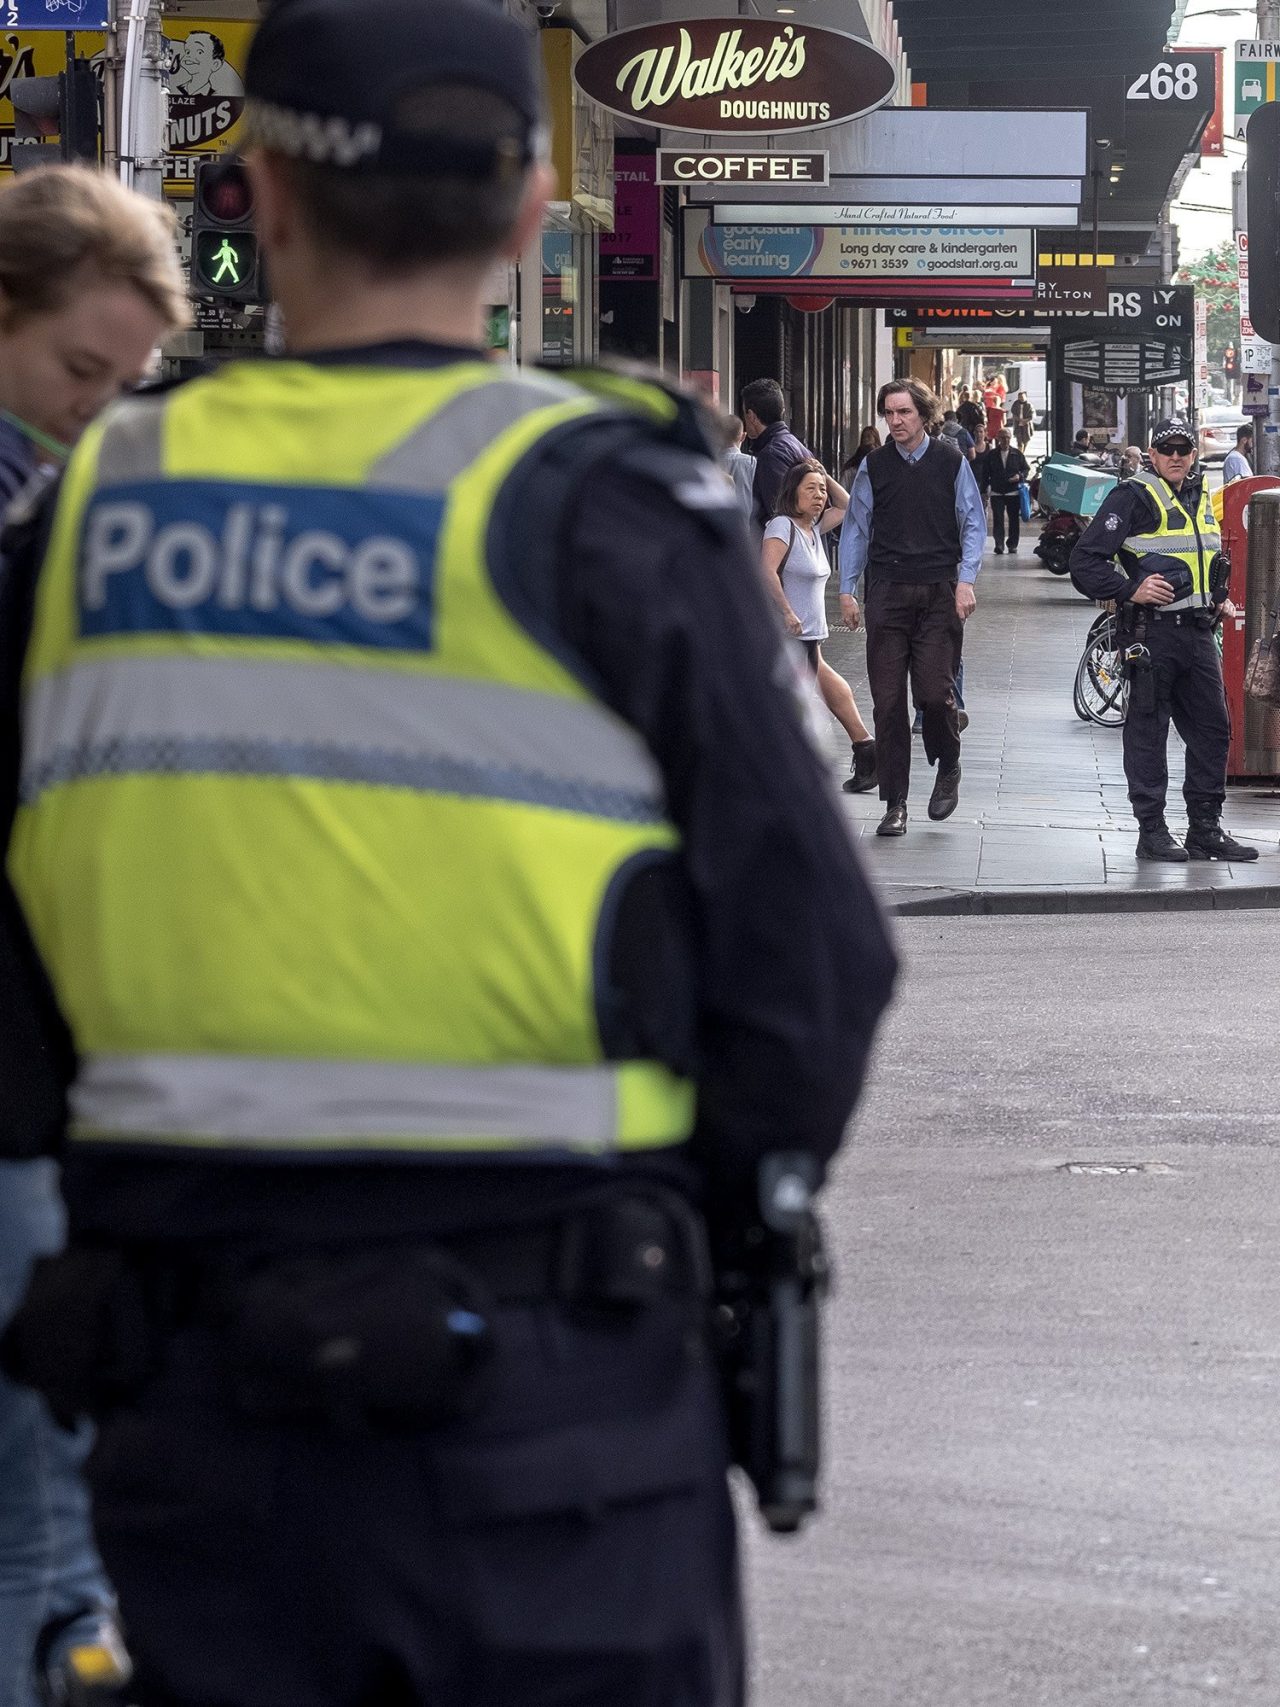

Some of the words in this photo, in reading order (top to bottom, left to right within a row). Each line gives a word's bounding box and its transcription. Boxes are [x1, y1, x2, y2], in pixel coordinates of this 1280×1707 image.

[6, 12, 19, 27] 2
[616, 26, 806, 111] Walker's
[720, 100, 831, 120] DOUGHNUTS
[673, 157, 813, 180] COFFEE
[864, 207, 896, 222] Crafted
[898, 207, 932, 220] Natural
[602, 232, 632, 244] 2017
[722, 236, 765, 253] early
[840, 243, 869, 256] Long
[872, 243, 895, 256] day
[899, 245, 926, 254] care
[929, 243, 938, 254] &
[941, 243, 1017, 256] kindergarten
[723, 251, 790, 270] learning
[851, 259, 878, 269] 9671
[881, 259, 909, 269] 3539
[927, 258, 1018, 271] goodstart.org.au
[1038, 282, 1057, 290] BY
[1037, 291, 1092, 299] HILTON
[83, 499, 421, 625] Police
